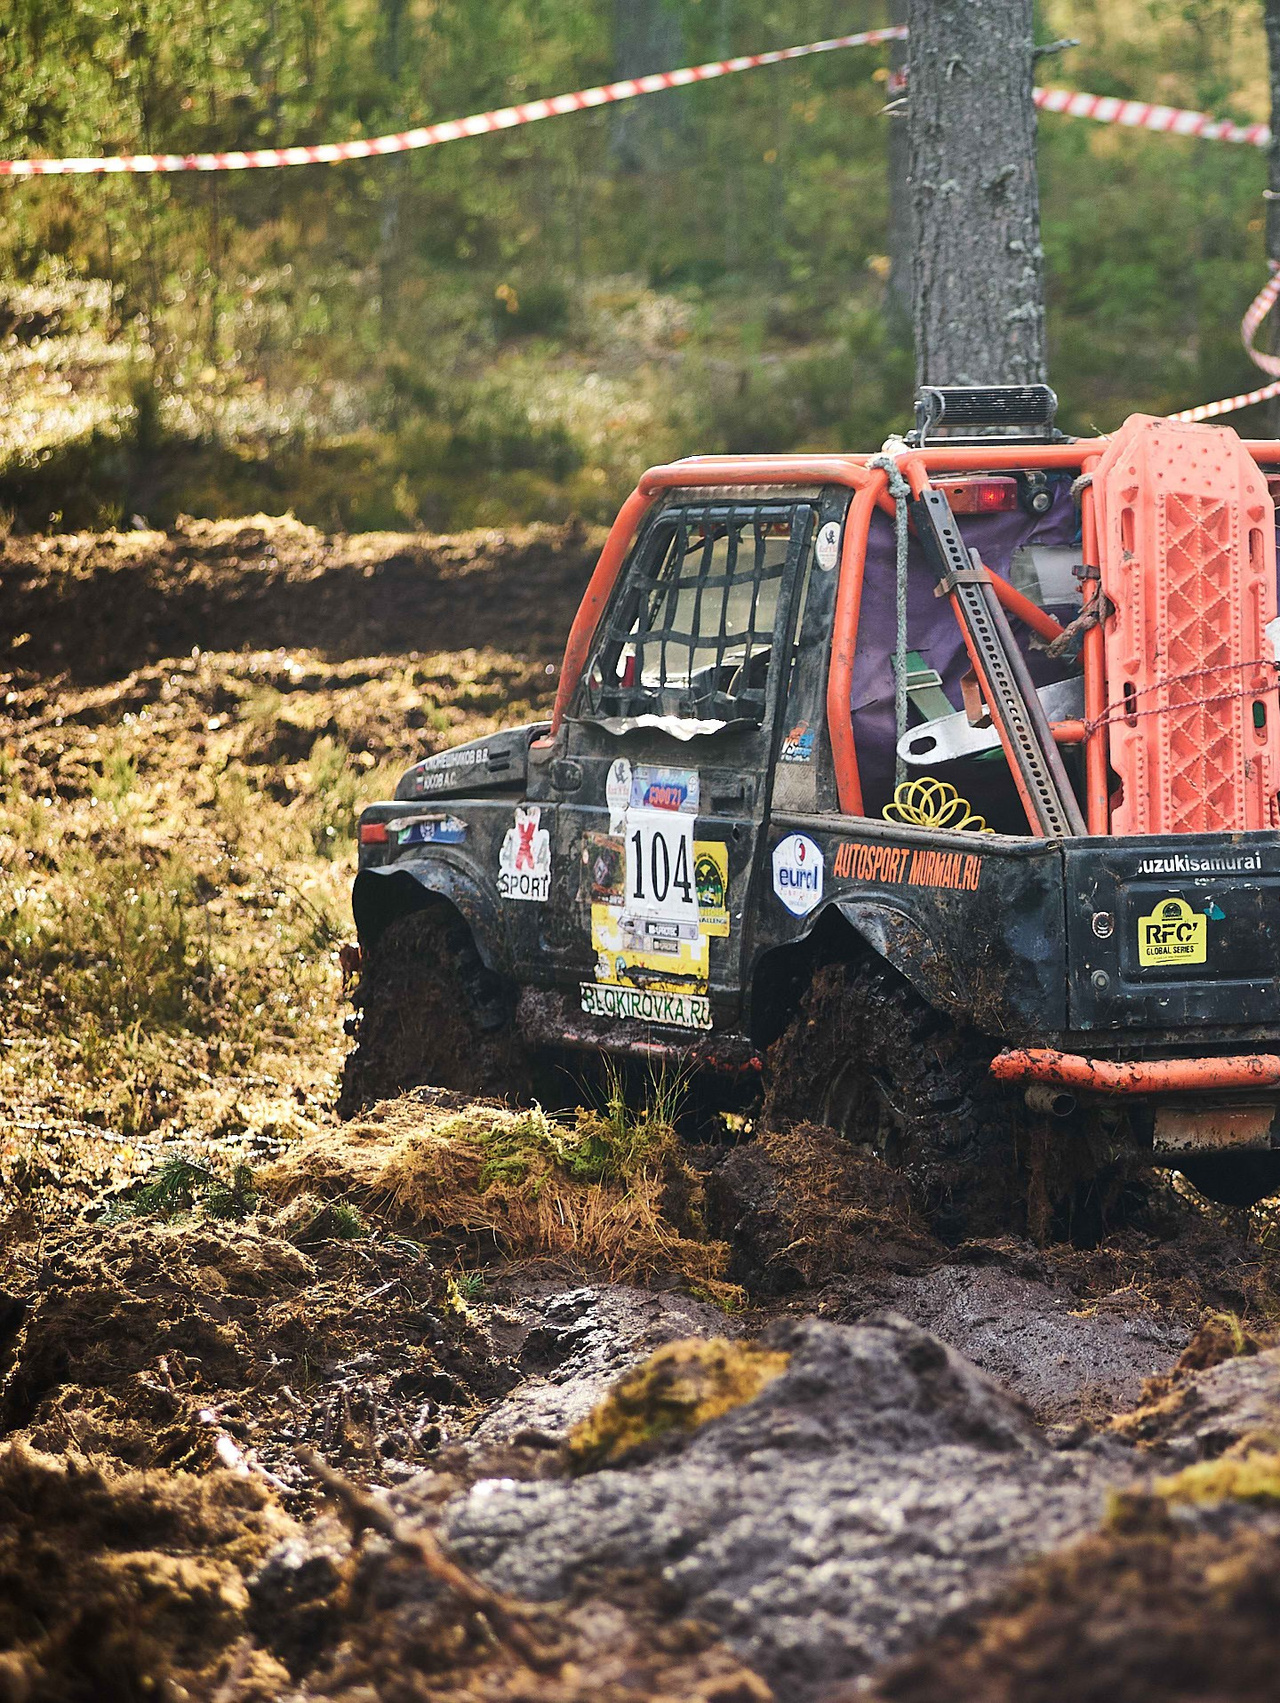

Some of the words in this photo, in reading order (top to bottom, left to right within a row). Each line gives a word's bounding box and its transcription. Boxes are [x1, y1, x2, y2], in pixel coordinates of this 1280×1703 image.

[631, 829, 694, 904] 104
[833, 842, 910, 883] AUTOSPORT
[907, 849, 982, 892] MURMAN.RU
[1138, 850, 1263, 874] uzukisamurai
[500, 873, 549, 897] SPORT
[779, 866, 818, 890] eurol
[1146, 946, 1171, 956] GLOBAL
[1172, 945, 1195, 955] SERIES
[581, 986, 712, 1026] BLOKIROVKA.RU
